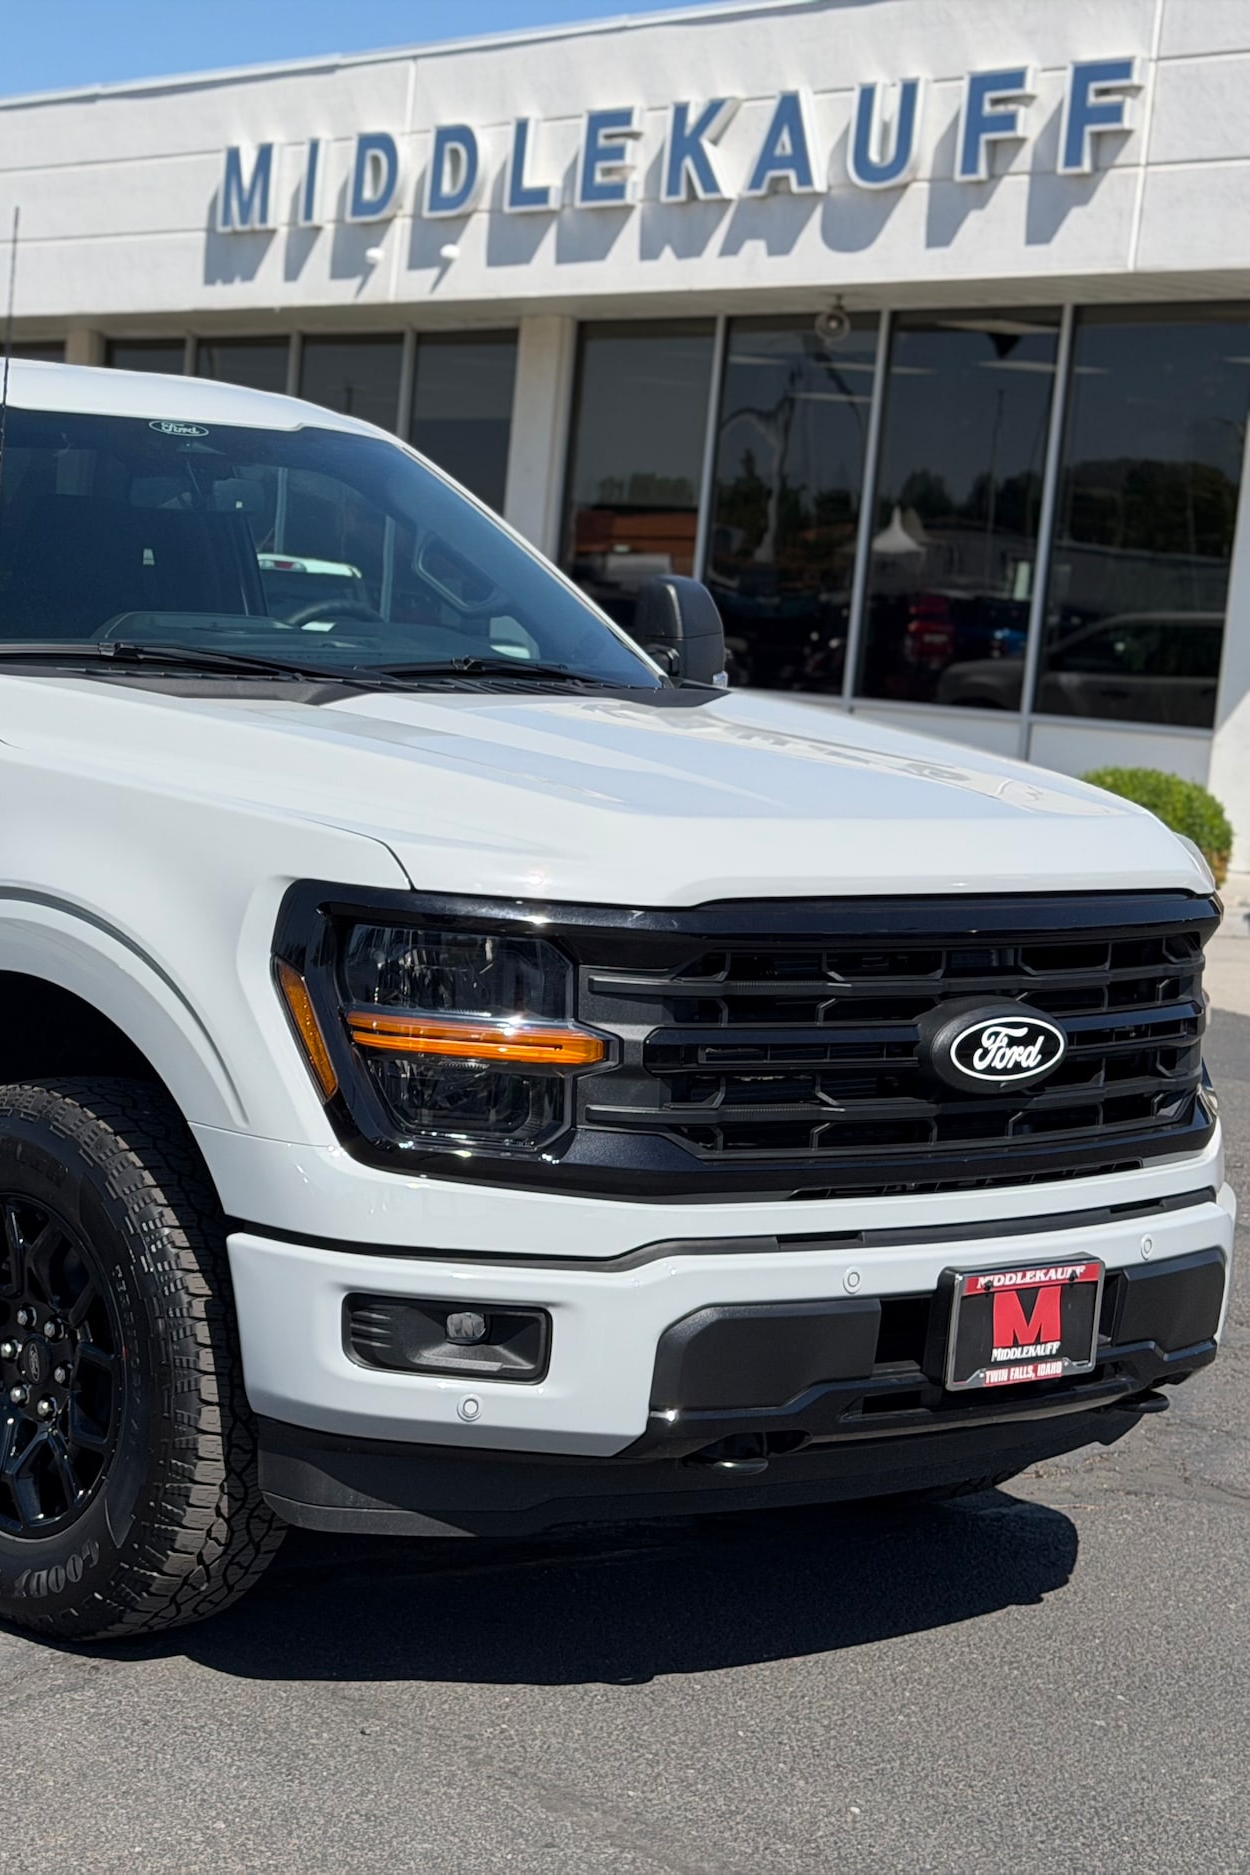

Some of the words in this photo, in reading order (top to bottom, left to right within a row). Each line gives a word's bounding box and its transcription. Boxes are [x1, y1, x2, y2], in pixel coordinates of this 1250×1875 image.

[218, 57, 1141, 232] MIDDLEKAUFF
[161, 421, 200, 434] Ford
[973, 1026, 1045, 1070] Ford
[993, 1285, 1062, 1347] M
[991, 1341, 1061, 1362] MIDDLEKAUFF
[985, 1368, 1008, 1384] TWIN
[1037, 1361, 1062, 1376] IDAHO
